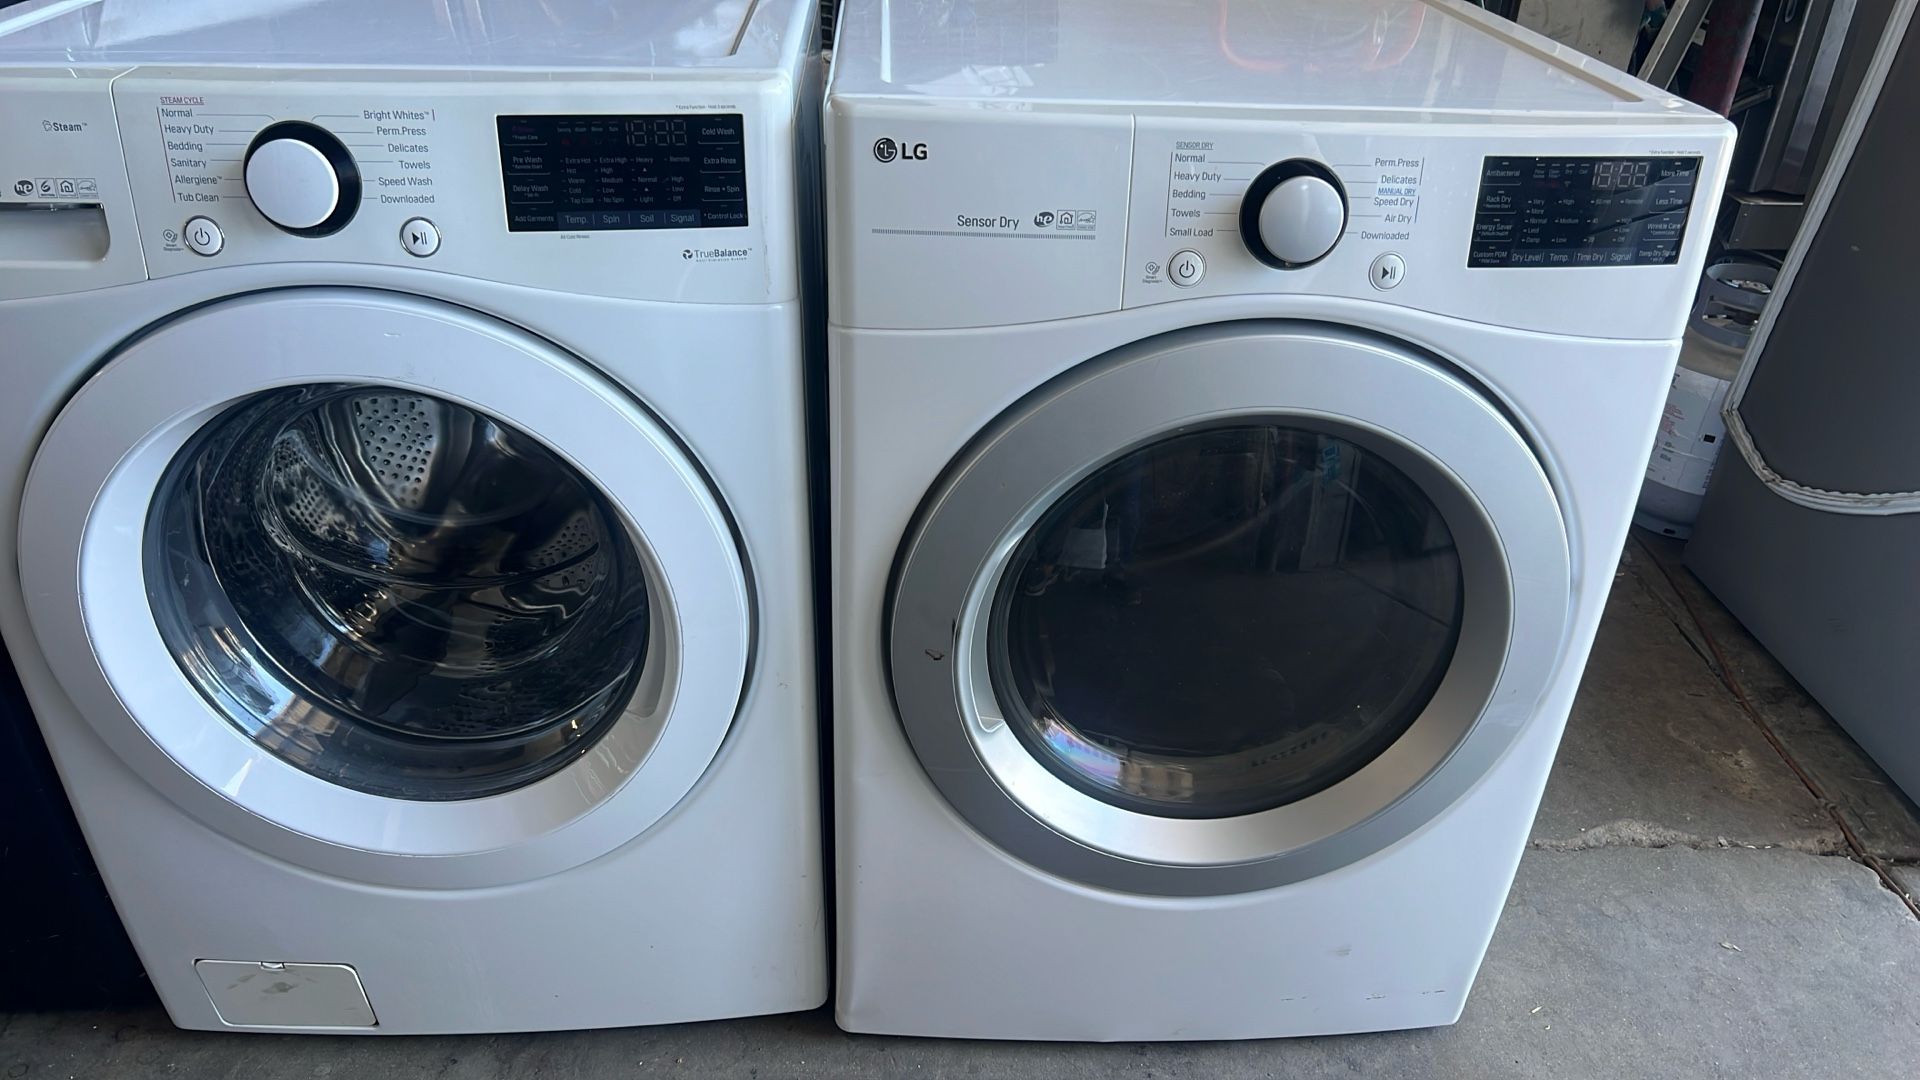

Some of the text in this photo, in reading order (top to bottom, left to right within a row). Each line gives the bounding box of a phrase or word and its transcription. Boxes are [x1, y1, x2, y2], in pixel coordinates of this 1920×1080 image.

[161, 108, 193, 118] Normal
[364, 110, 391, 121] Bright
[164, 124, 214, 135] Heavy Duty
[167, 141, 203, 152] Bedding
[388, 143, 429, 152] Delicates
[902, 143, 928, 160] LG
[170, 158, 206, 168] Sanitary
[1175, 153, 1206, 163] Normal
[398, 160, 431, 169] Towels
[378, 177, 433, 187] Speed Wash
[1174, 171, 1222, 183] Heavy Duty
[1381, 175, 1417, 184] Delicates
[177, 192, 220, 202] Tub Clean
[381, 194, 435, 203] Downloaded
[1172, 189, 1206, 200] Bedding
[1373, 197, 1414, 207] Speed Dry
[1171, 208, 1201, 217] Towels
[565, 215, 588, 224] Temp.
[603, 214, 620, 224] Spin
[640, 214, 654, 223] Soil
[670, 214, 695, 224] Signal
[957, 215, 1019, 230] Sensor Dry
[1384, 214, 1412, 224] Air Dry
[1170, 228, 1214, 237] Small Load
[1476, 224, 1495, 232] Energy
[1361, 231, 1410, 240] Downloaded
[1512, 253, 1542, 262] Dry Level
[1550, 253, 1569, 262] Temp.
[1592, 253, 1604, 262] Dry
[1610, 252, 1632, 262] Signal
[1652, 250, 1662, 258] Dry
